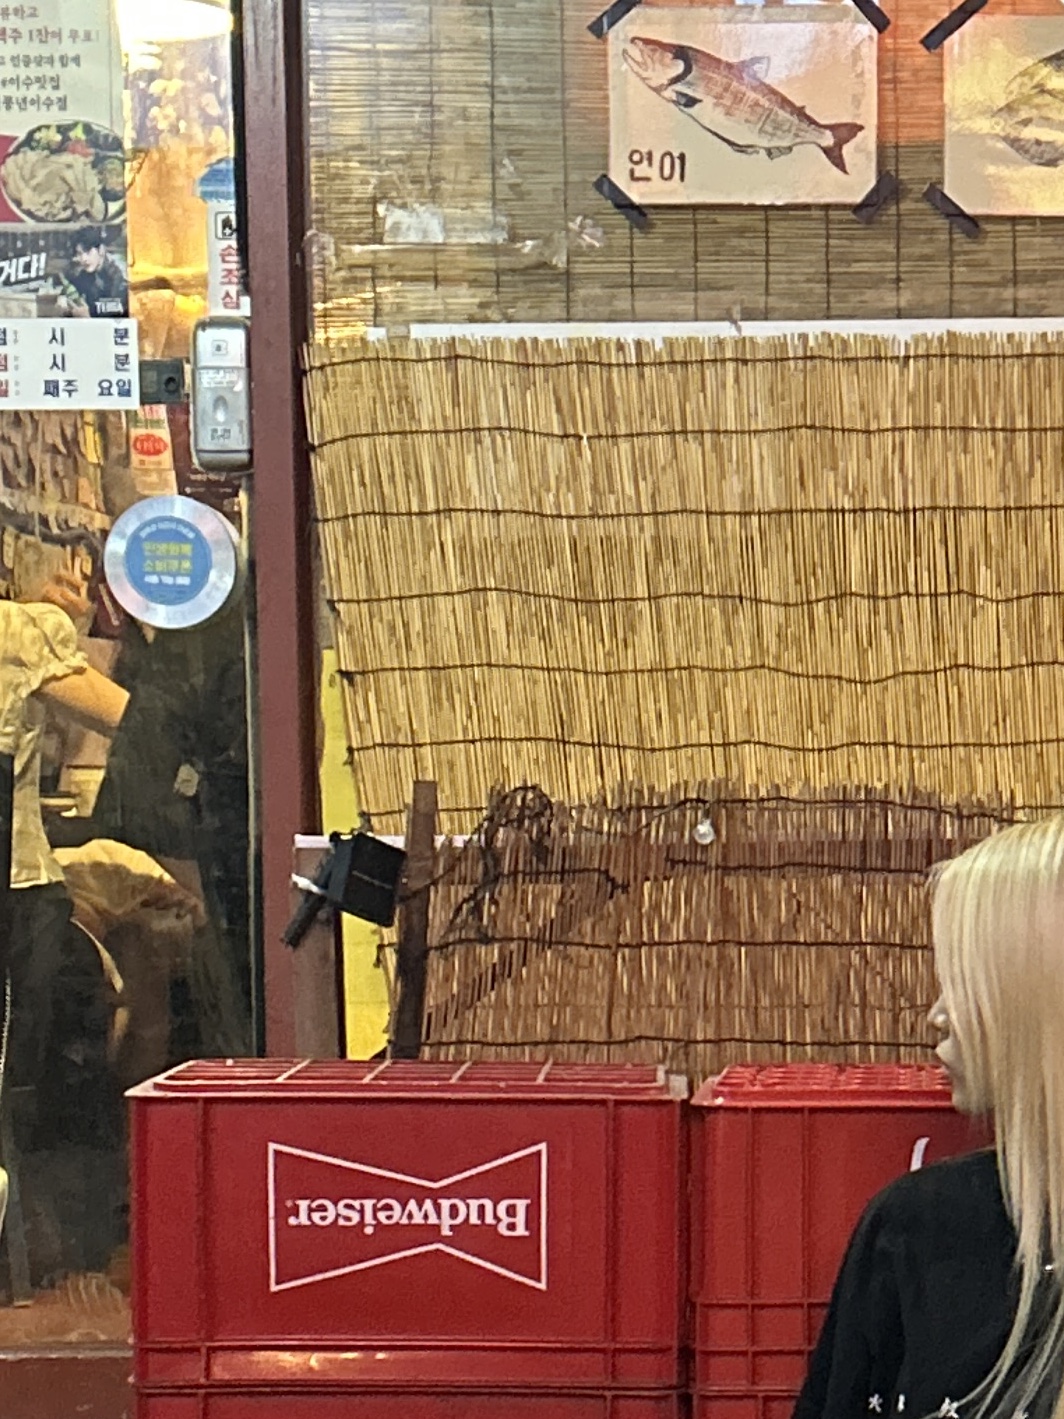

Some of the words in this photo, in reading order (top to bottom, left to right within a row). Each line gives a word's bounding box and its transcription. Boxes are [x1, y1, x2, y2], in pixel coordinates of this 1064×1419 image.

[48, 326, 66, 347] 시
[49, 352, 66, 373] 시
[97, 378, 132, 398] 요일
[288, 1197, 532, 1237] Budweiser
